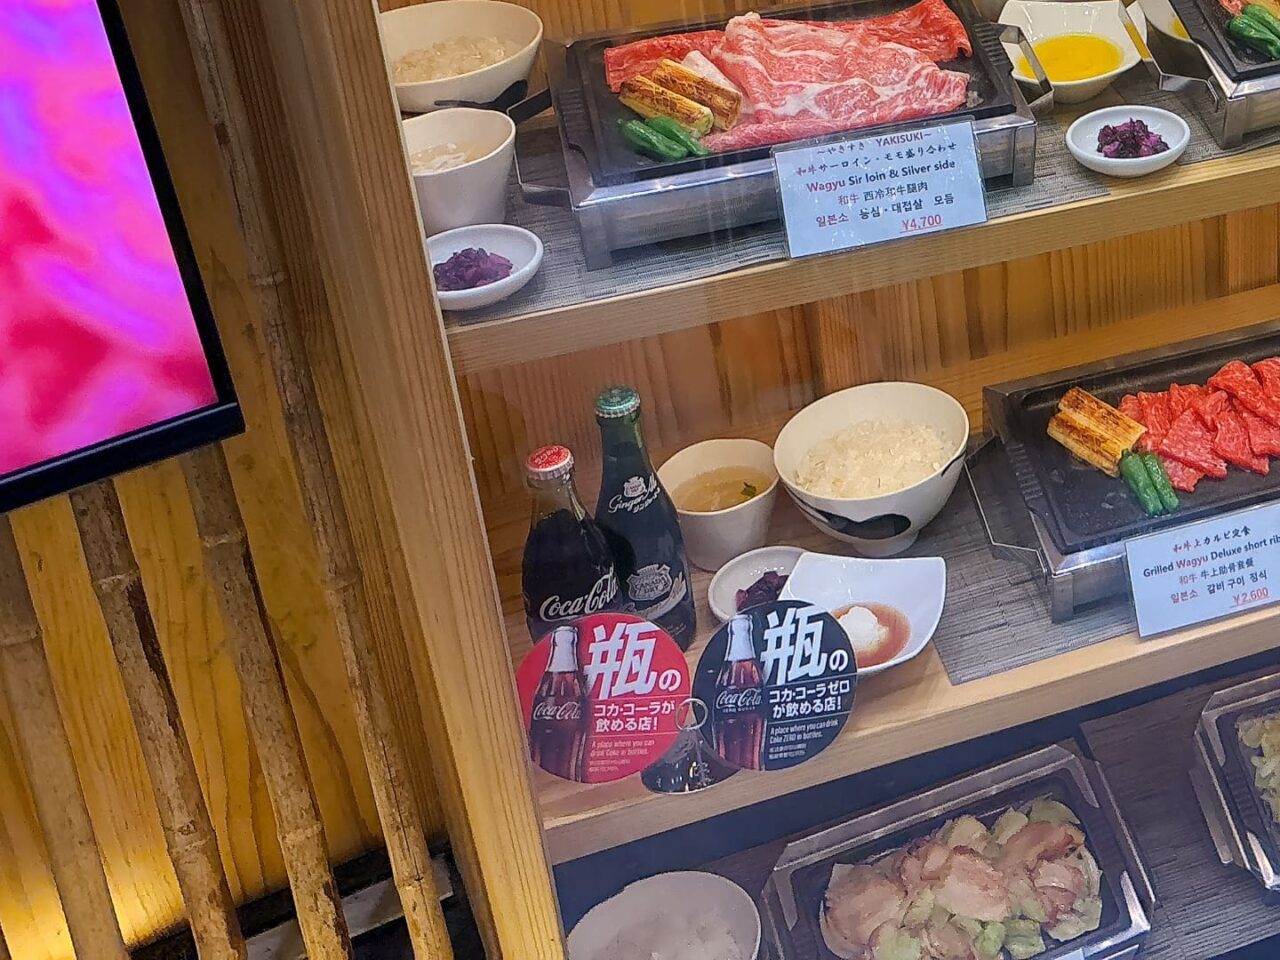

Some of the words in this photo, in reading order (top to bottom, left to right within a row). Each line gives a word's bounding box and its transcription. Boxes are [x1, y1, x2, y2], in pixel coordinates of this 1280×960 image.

[806, 178, 846, 192] Wagyu
[849, 176, 862, 185] Sir
[865, 172, 886, 183] loin
[889, 170, 899, 178] &
[902, 165, 931, 176] Silver
[934, 160, 955, 171] side
[837, 193, 860, 207] 和牛
[816, 212, 849, 227] 일본소
[901, 214, 942, 232] ¥4,700
[608, 494, 644, 513] Ginger
[1174, 526, 1251, 552] 和牛上カルビ定食
[1144, 562, 1174, 577] Grilled
[1176, 555, 1208, 568] Wagyu
[1211, 547, 1242, 560] Deluxe
[1244, 539, 1267, 552] short
[1171, 589, 1199, 604] 일본소
[1228, 576, 1245, 589] 구이
[1250, 570, 1267, 583] 정식
[1179, 573, 1197, 585] 和牛
[1232, 586, 1268, 606] ¥2,600
[761, 607, 849, 686] 瓶の
[583, 621, 681, 701] 瓶の
[775, 726, 789, 736] place
[790, 724, 806, 732] where
[807, 724, 816, 732] you
[826, 719, 838, 727] drink
[770, 735, 782, 744] Coke
[783, 733, 796, 742] ZERO
